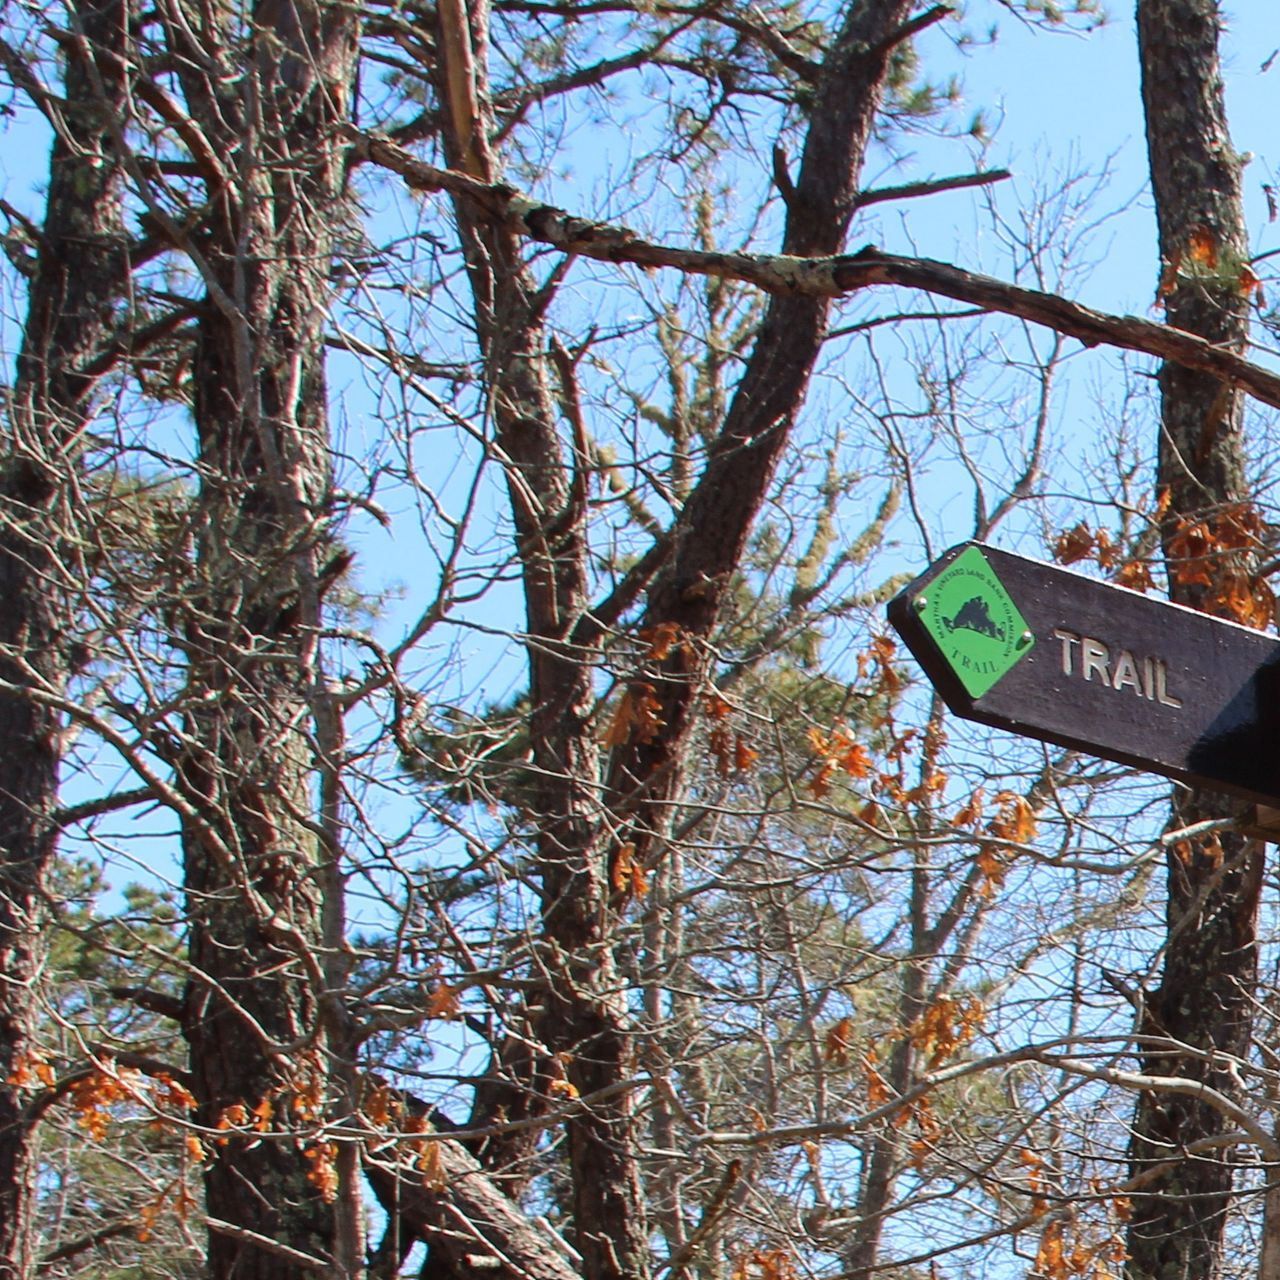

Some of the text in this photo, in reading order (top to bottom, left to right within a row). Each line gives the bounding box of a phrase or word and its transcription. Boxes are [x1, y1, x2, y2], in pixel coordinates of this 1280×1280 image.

[966, 568, 986, 580] LAND
[951, 647, 999, 674] TRAIL
[1053, 628, 1183, 709] TRAIL
